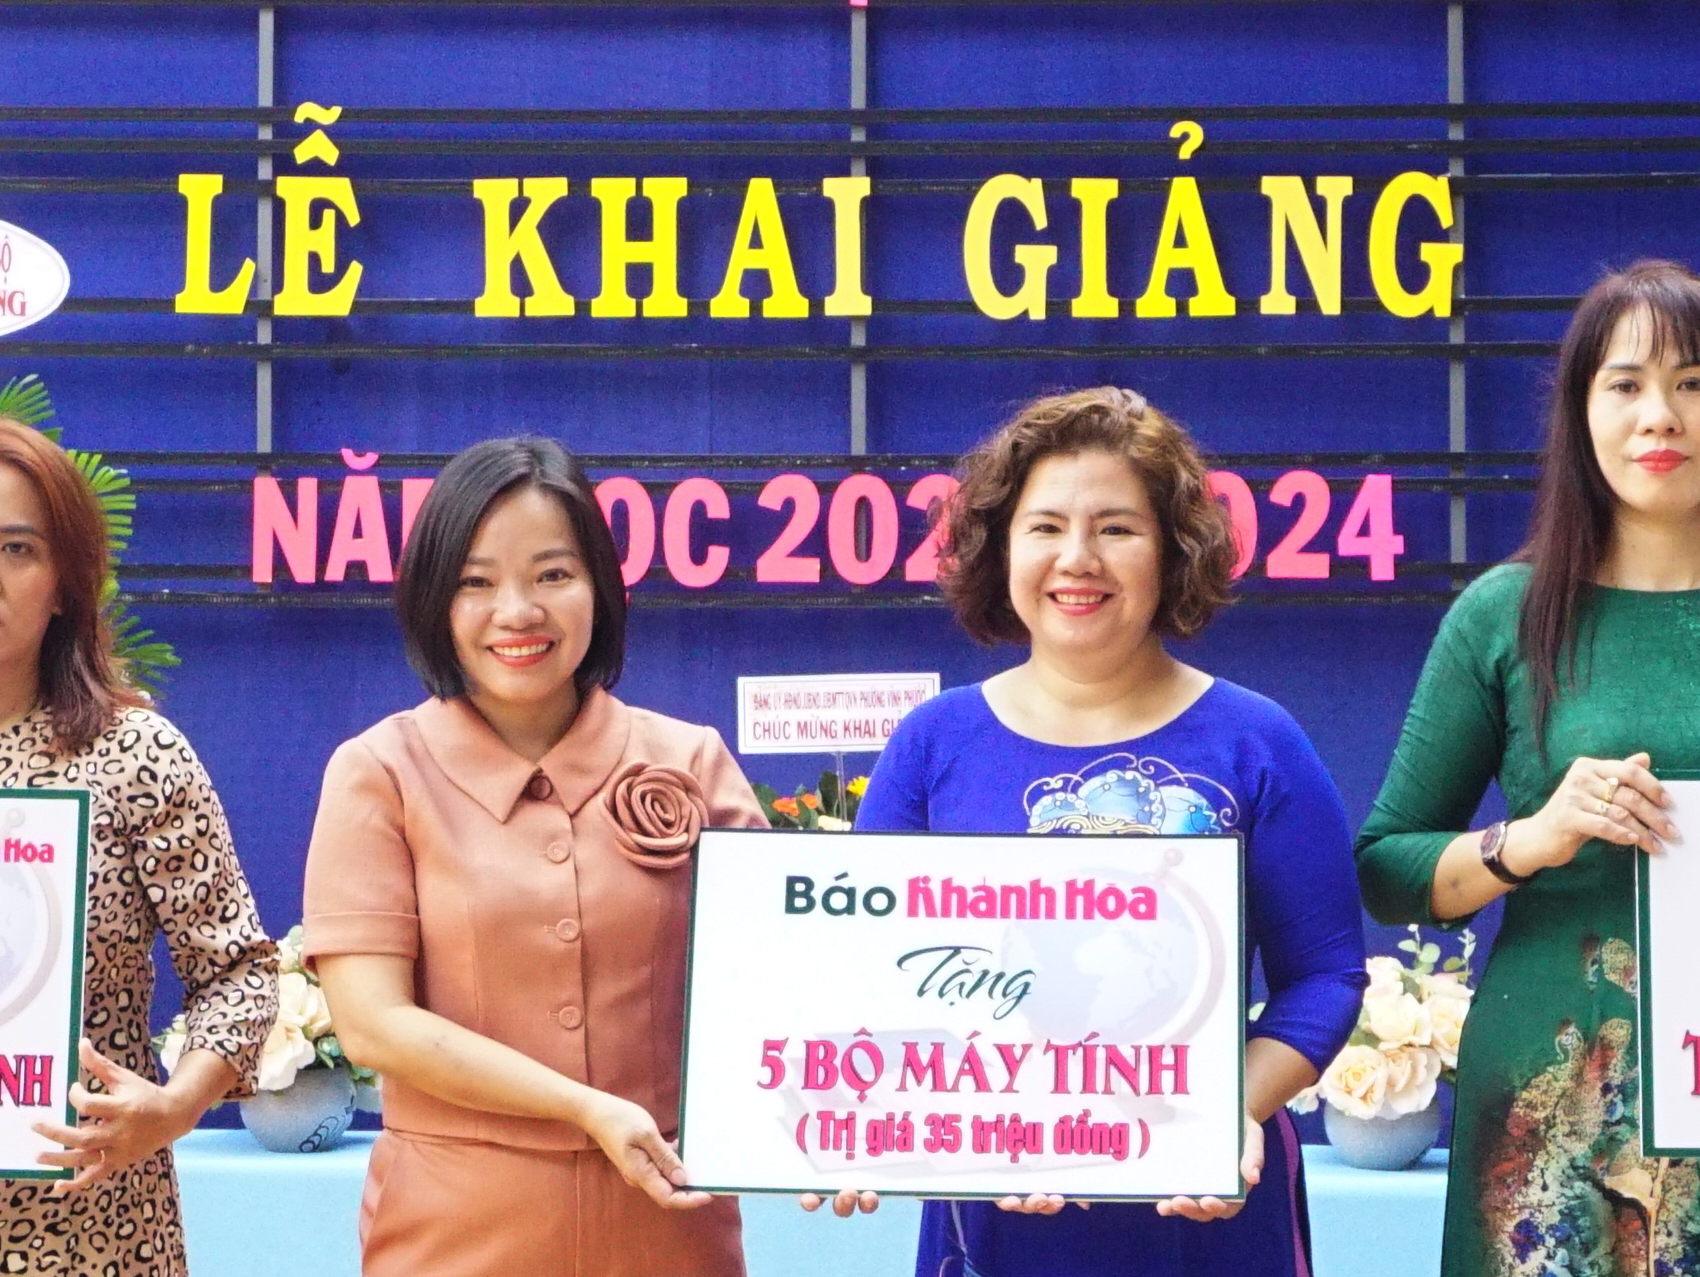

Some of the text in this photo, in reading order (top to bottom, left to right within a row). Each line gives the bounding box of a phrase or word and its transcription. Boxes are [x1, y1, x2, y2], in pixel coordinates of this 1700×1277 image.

[175, 102, 1462, 319] LỄ KHAI GIẢNG
[594, 477, 731, 605] ỌC
[757, 474, 962, 585] 202
[753, 714, 791, 740] CHÚC
[843, 719, 876, 738] KHAI
[785, 873, 897, 917] Báo
[896, 945, 1037, 1020] Tặng
[757, 1027, 1190, 1102] 5 BỘ MÁY TÍNH
[866, 1112, 914, 1155] giá
[924, 1114, 962, 1153] 35
[971, 1114, 1044, 1163] triệu
